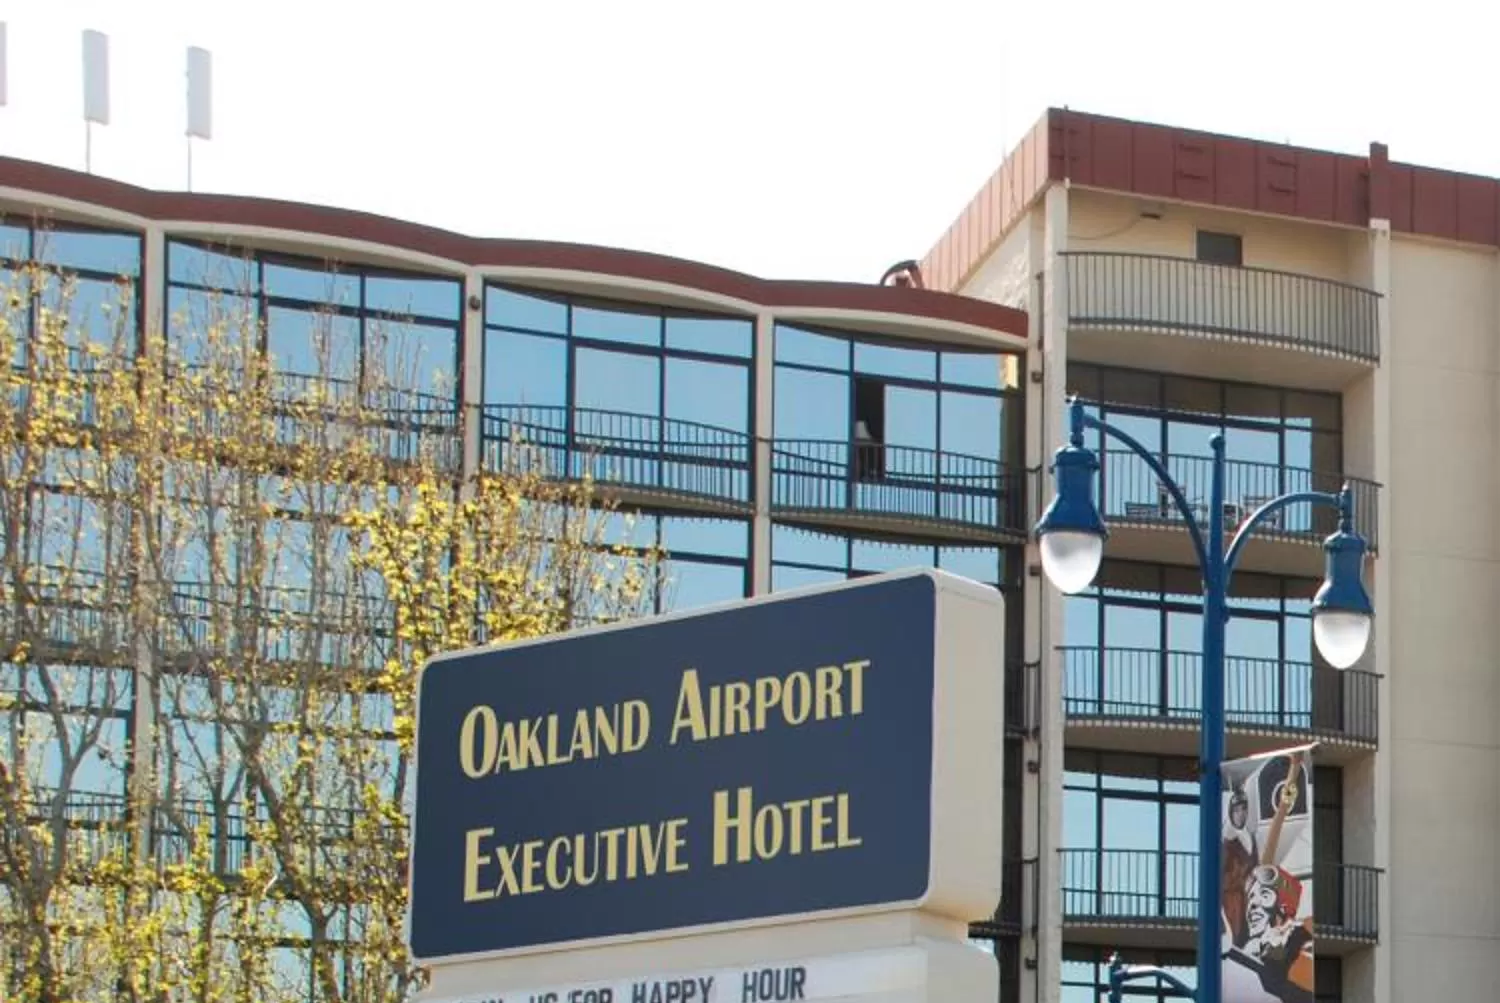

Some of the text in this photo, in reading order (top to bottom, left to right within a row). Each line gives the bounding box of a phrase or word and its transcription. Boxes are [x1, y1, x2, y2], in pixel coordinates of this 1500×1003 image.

[459, 659, 872, 779] OAKLAND AIRPORT
[462, 786, 863, 903] EXECUTIVE HOTEL
